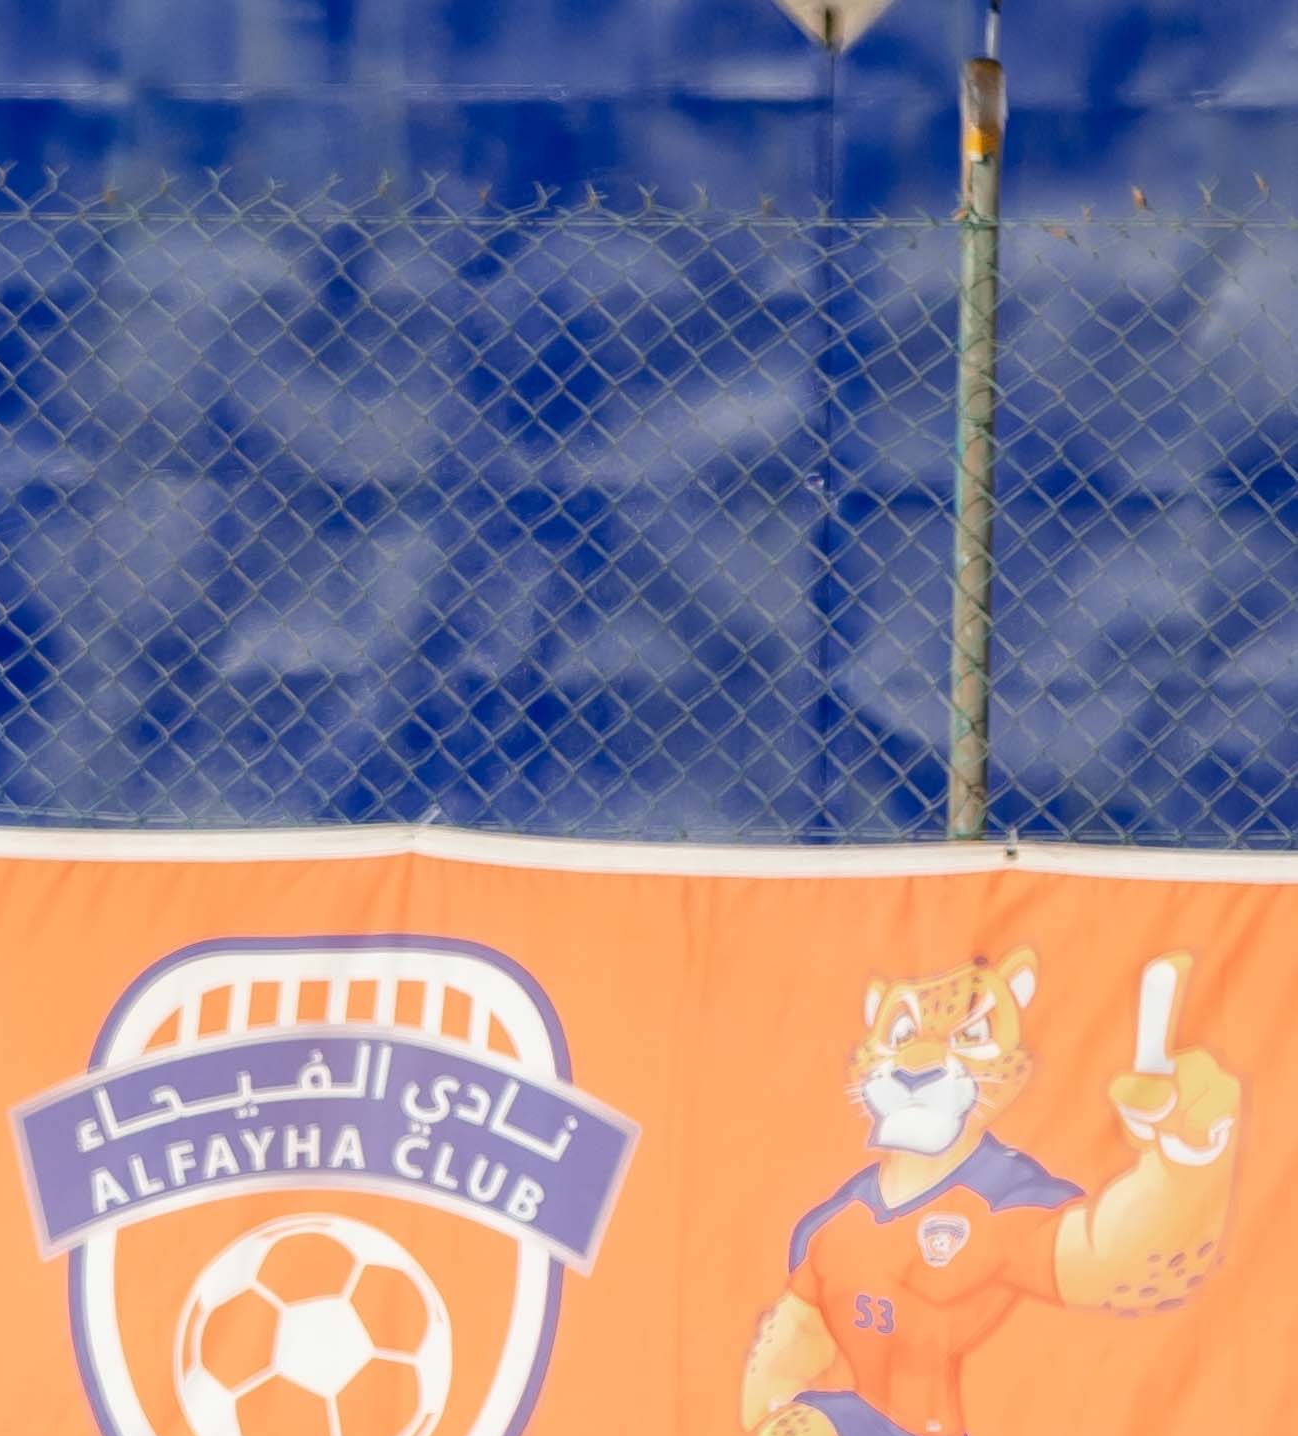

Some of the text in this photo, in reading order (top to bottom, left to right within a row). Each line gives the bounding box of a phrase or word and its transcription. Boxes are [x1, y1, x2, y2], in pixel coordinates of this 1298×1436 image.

[77, 1041, 579, 1163] نادي الفيحاء
[91, 1124, 546, 1223] ALFAYHA CLUB
[854, 1293, 894, 1334] 53
